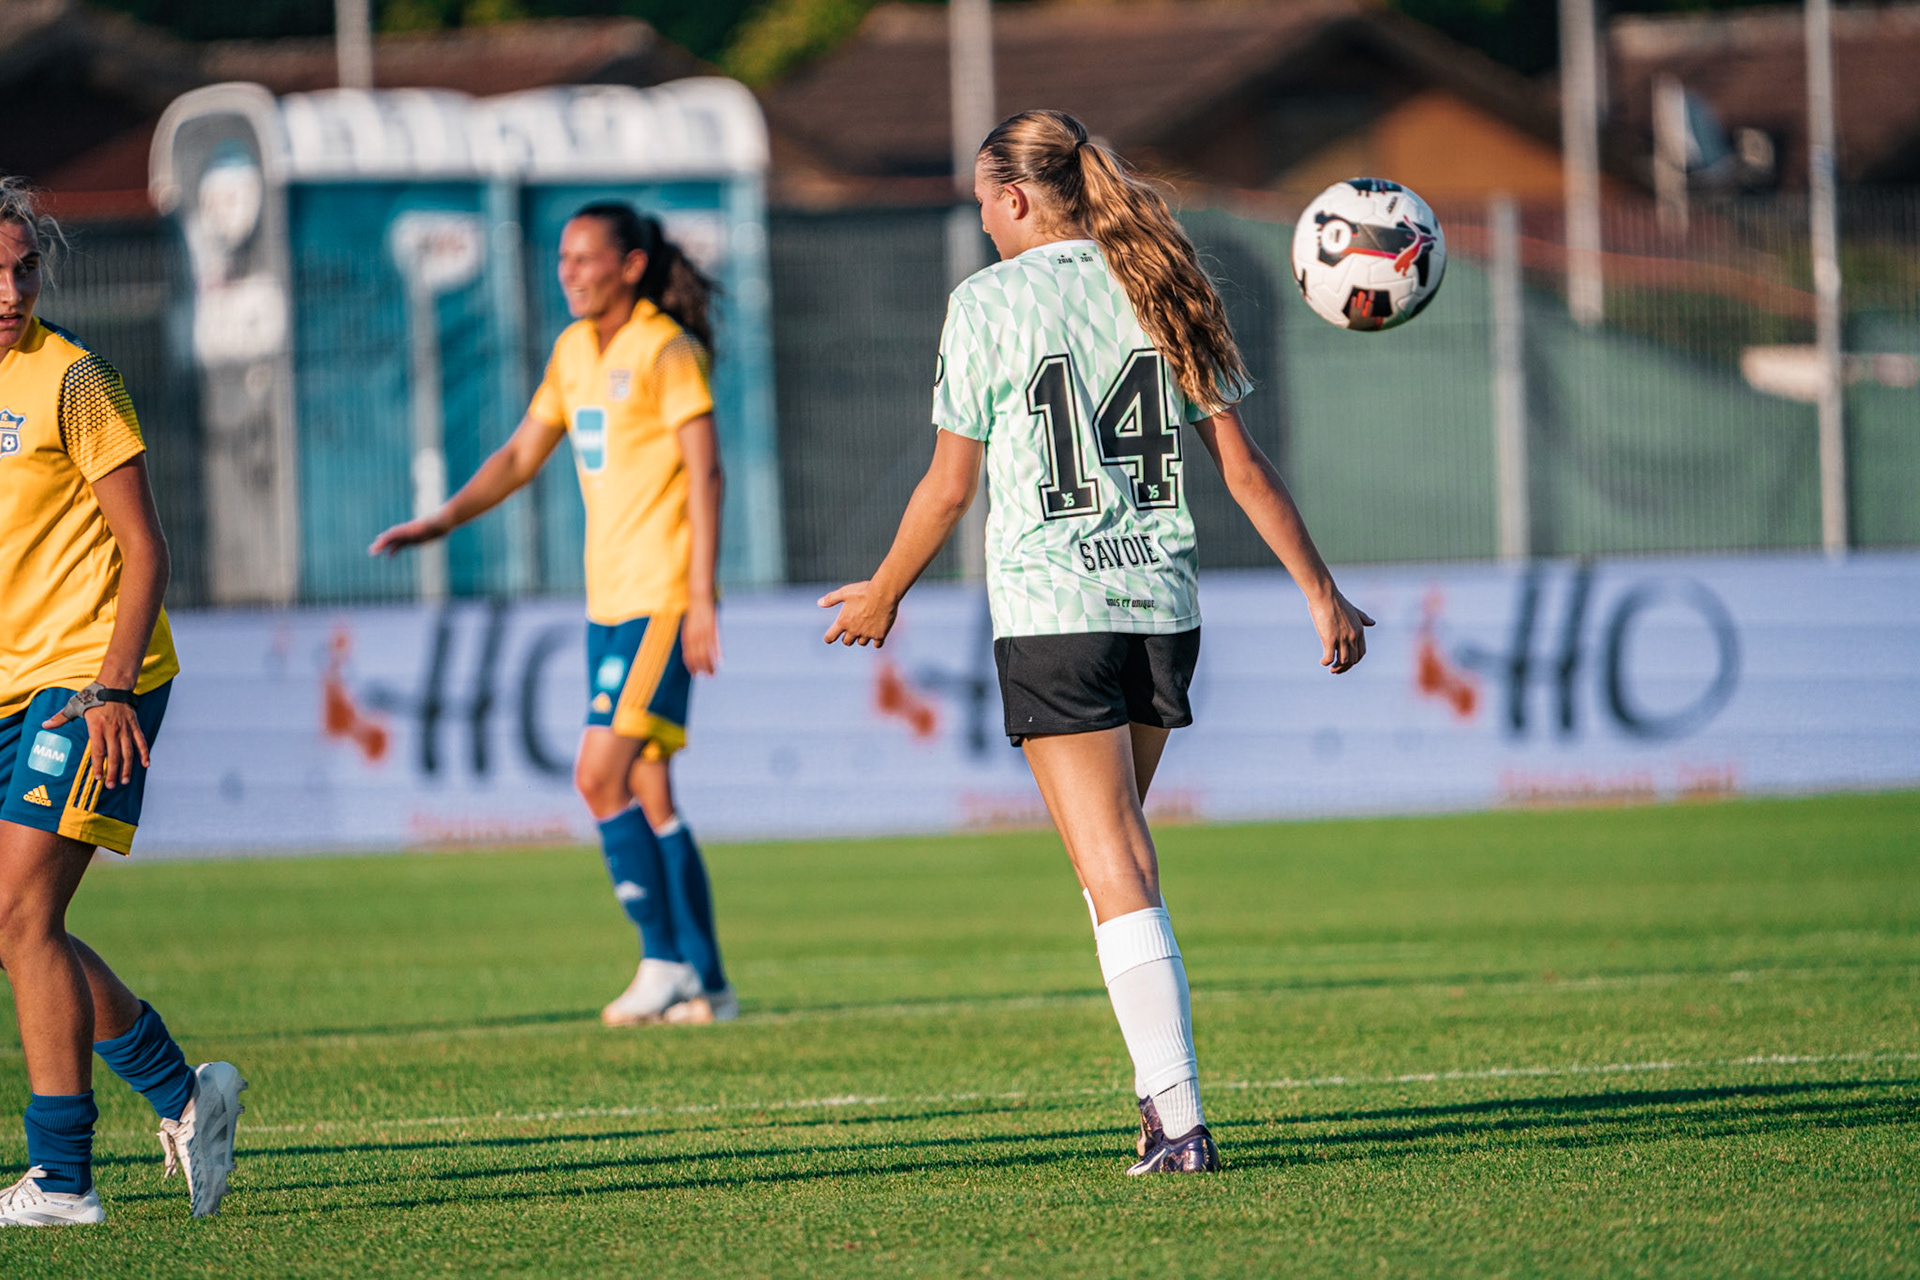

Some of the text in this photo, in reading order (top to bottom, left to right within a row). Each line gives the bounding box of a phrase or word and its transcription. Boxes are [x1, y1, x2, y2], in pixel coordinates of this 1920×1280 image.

[1025, 348, 1182, 521] 14
[1079, 534, 1161, 572] SAVOIE
[33, 744, 65, 762] MAM
